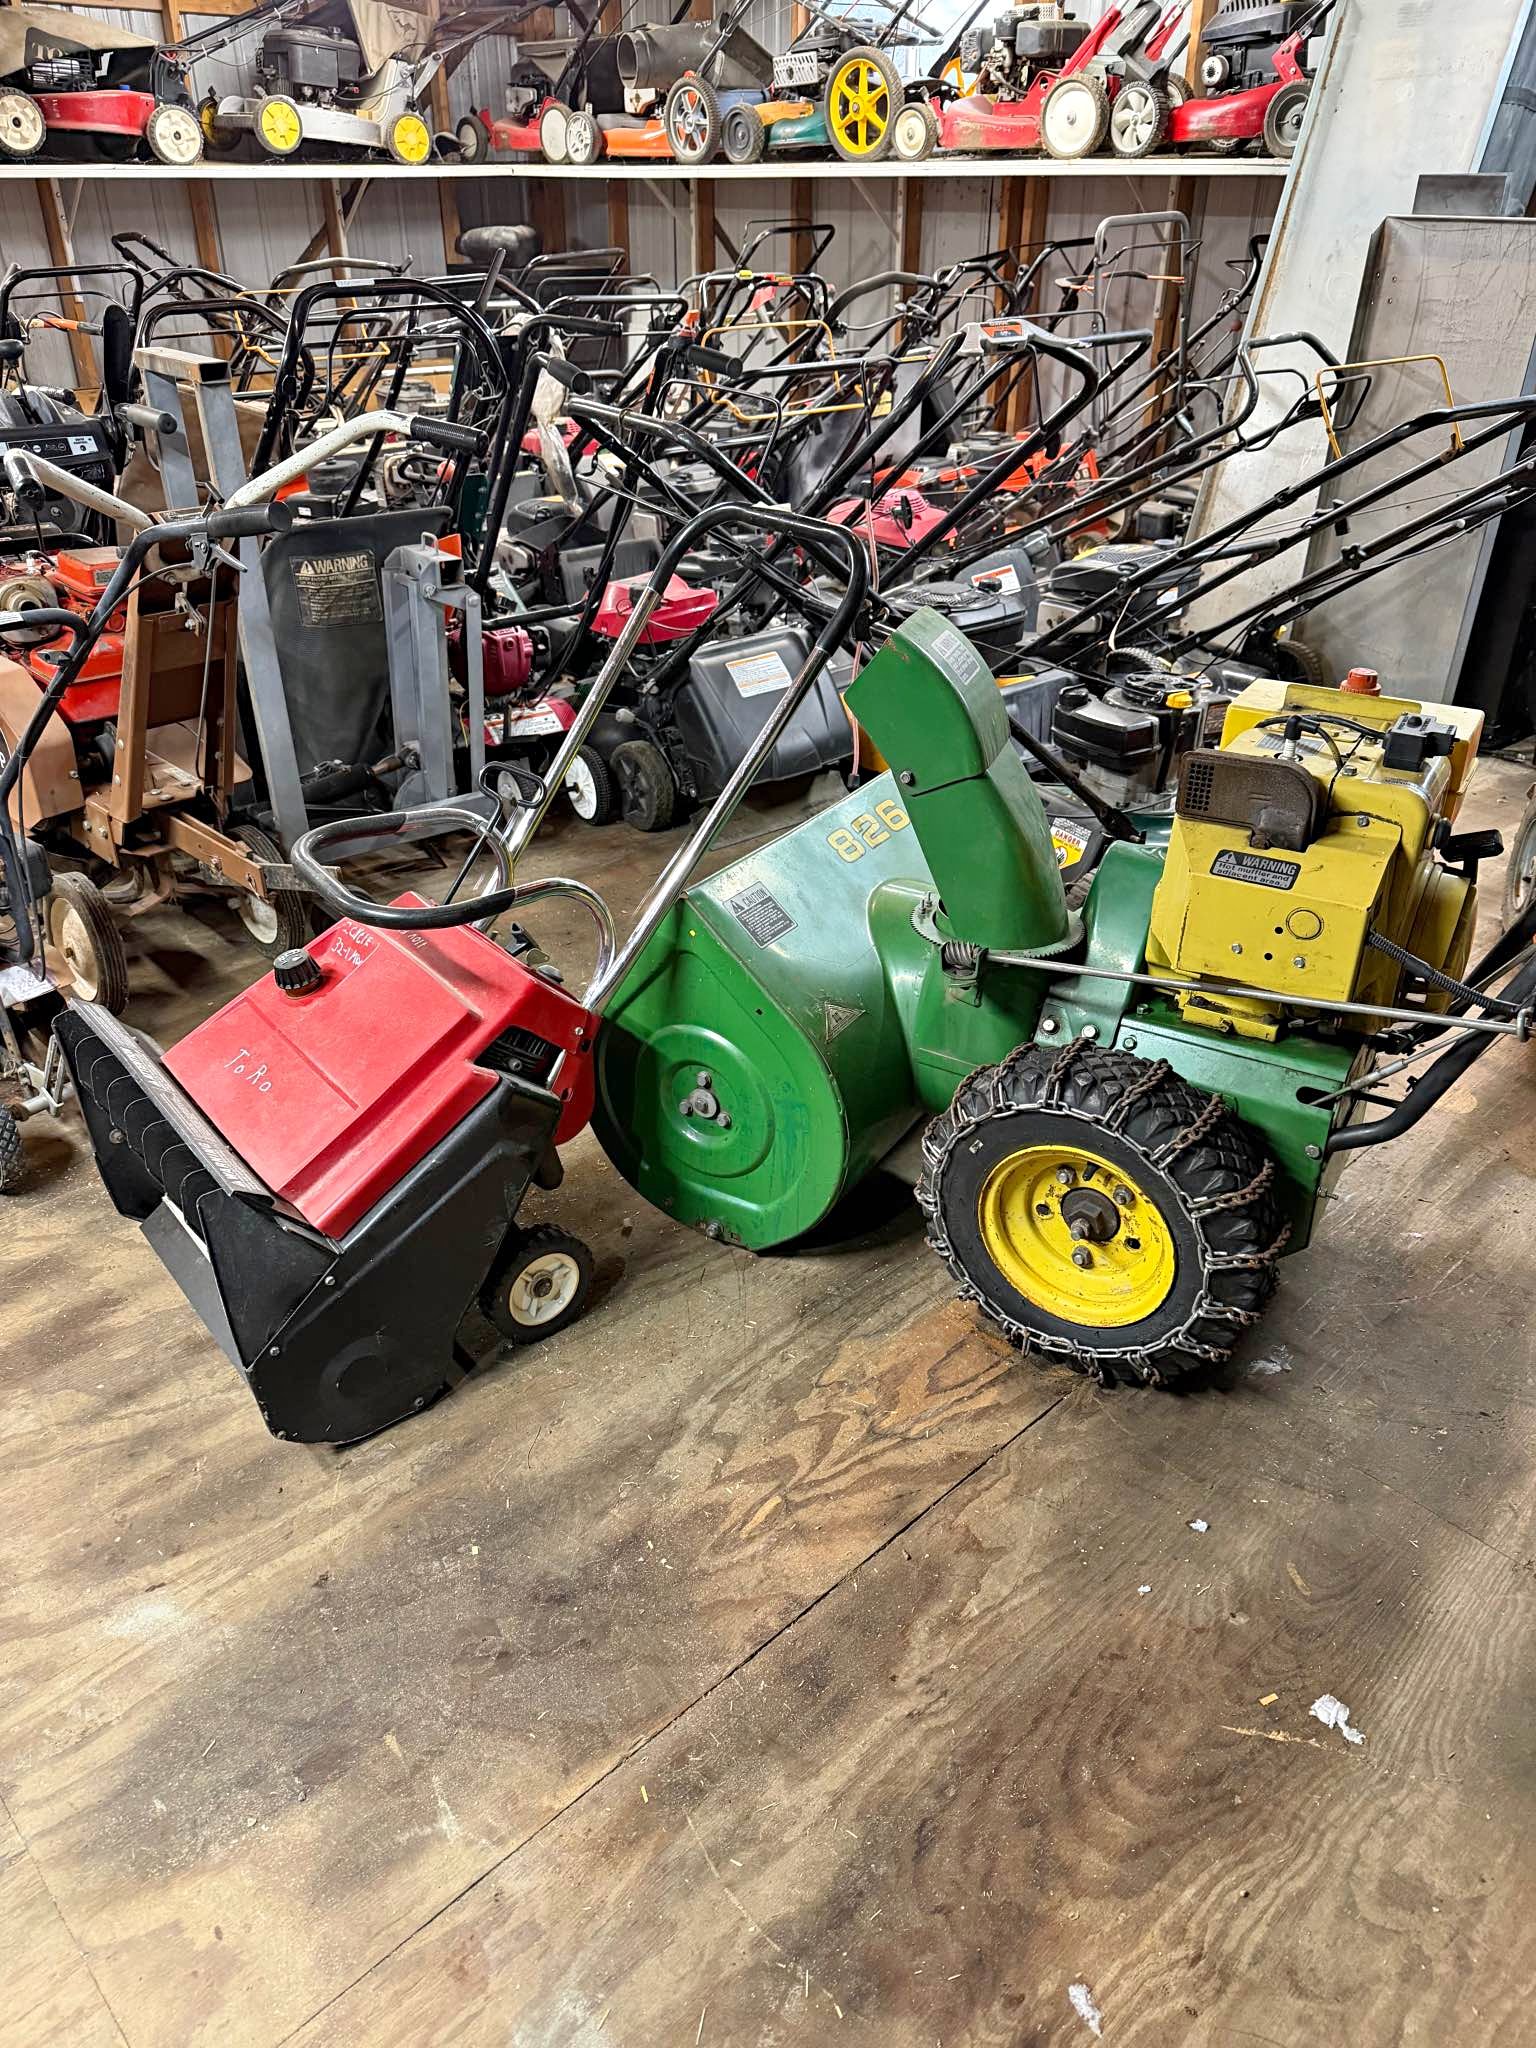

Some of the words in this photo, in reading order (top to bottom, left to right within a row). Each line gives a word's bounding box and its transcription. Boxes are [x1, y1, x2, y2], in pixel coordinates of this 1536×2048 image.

[313, 554, 368, 574] WARNING
[826, 799, 911, 863] 826
[1216, 869, 1258, 881] adjacent
[1219, 862, 1238, 871] Hot
[1237, 866, 1271, 878] muffler
[1271, 873, 1290, 882] and
[1241, 854, 1297, 876] WARNING
[742, 887, 768, 908] CAUTION
